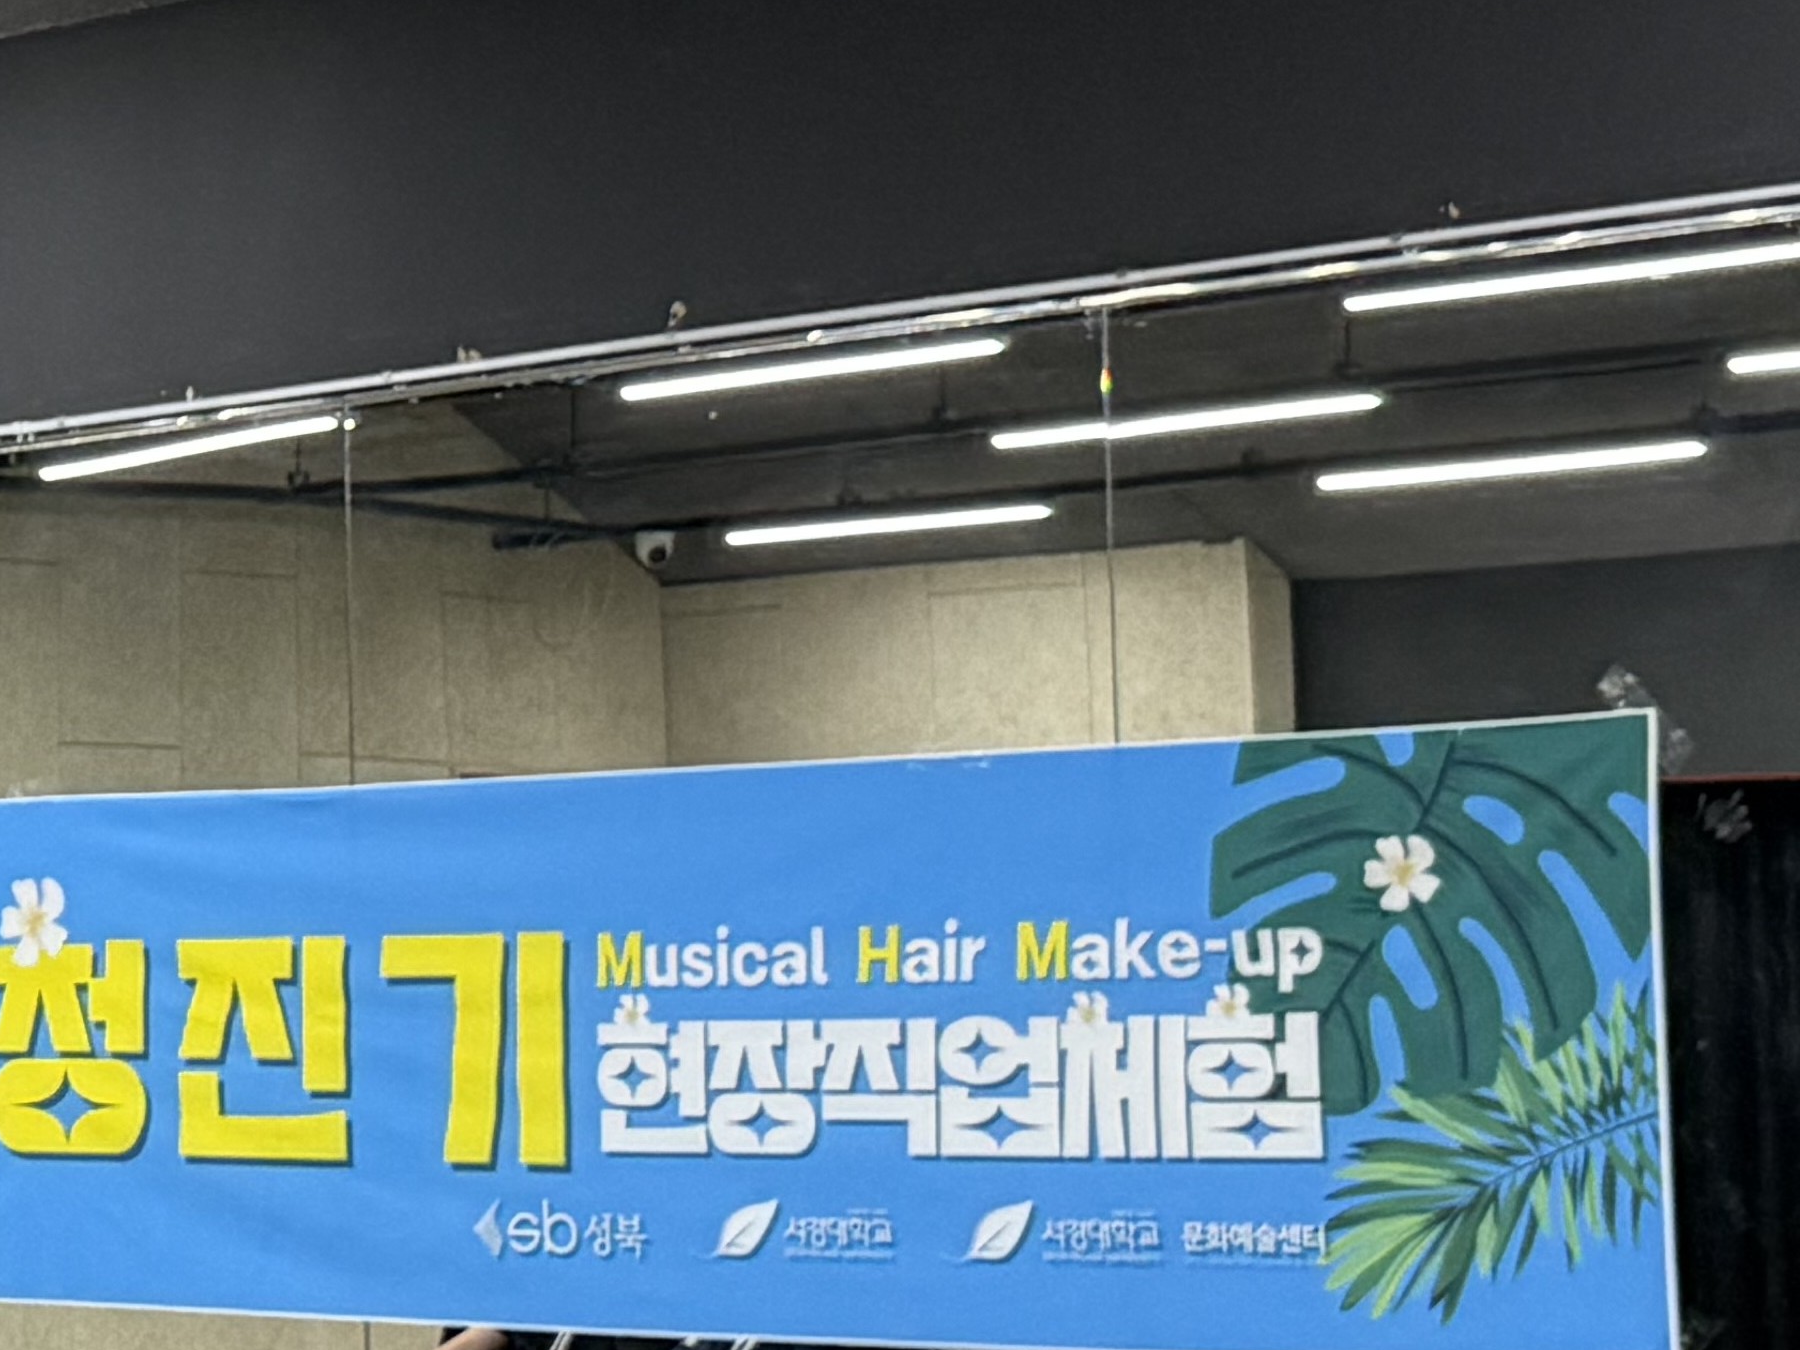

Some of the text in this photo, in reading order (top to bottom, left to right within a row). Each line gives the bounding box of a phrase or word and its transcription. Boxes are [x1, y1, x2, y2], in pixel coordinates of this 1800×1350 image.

[597, 918, 1324, 993] Musical Hair Make-up
[596, 1002, 1325, 1160] 현장직업체험
